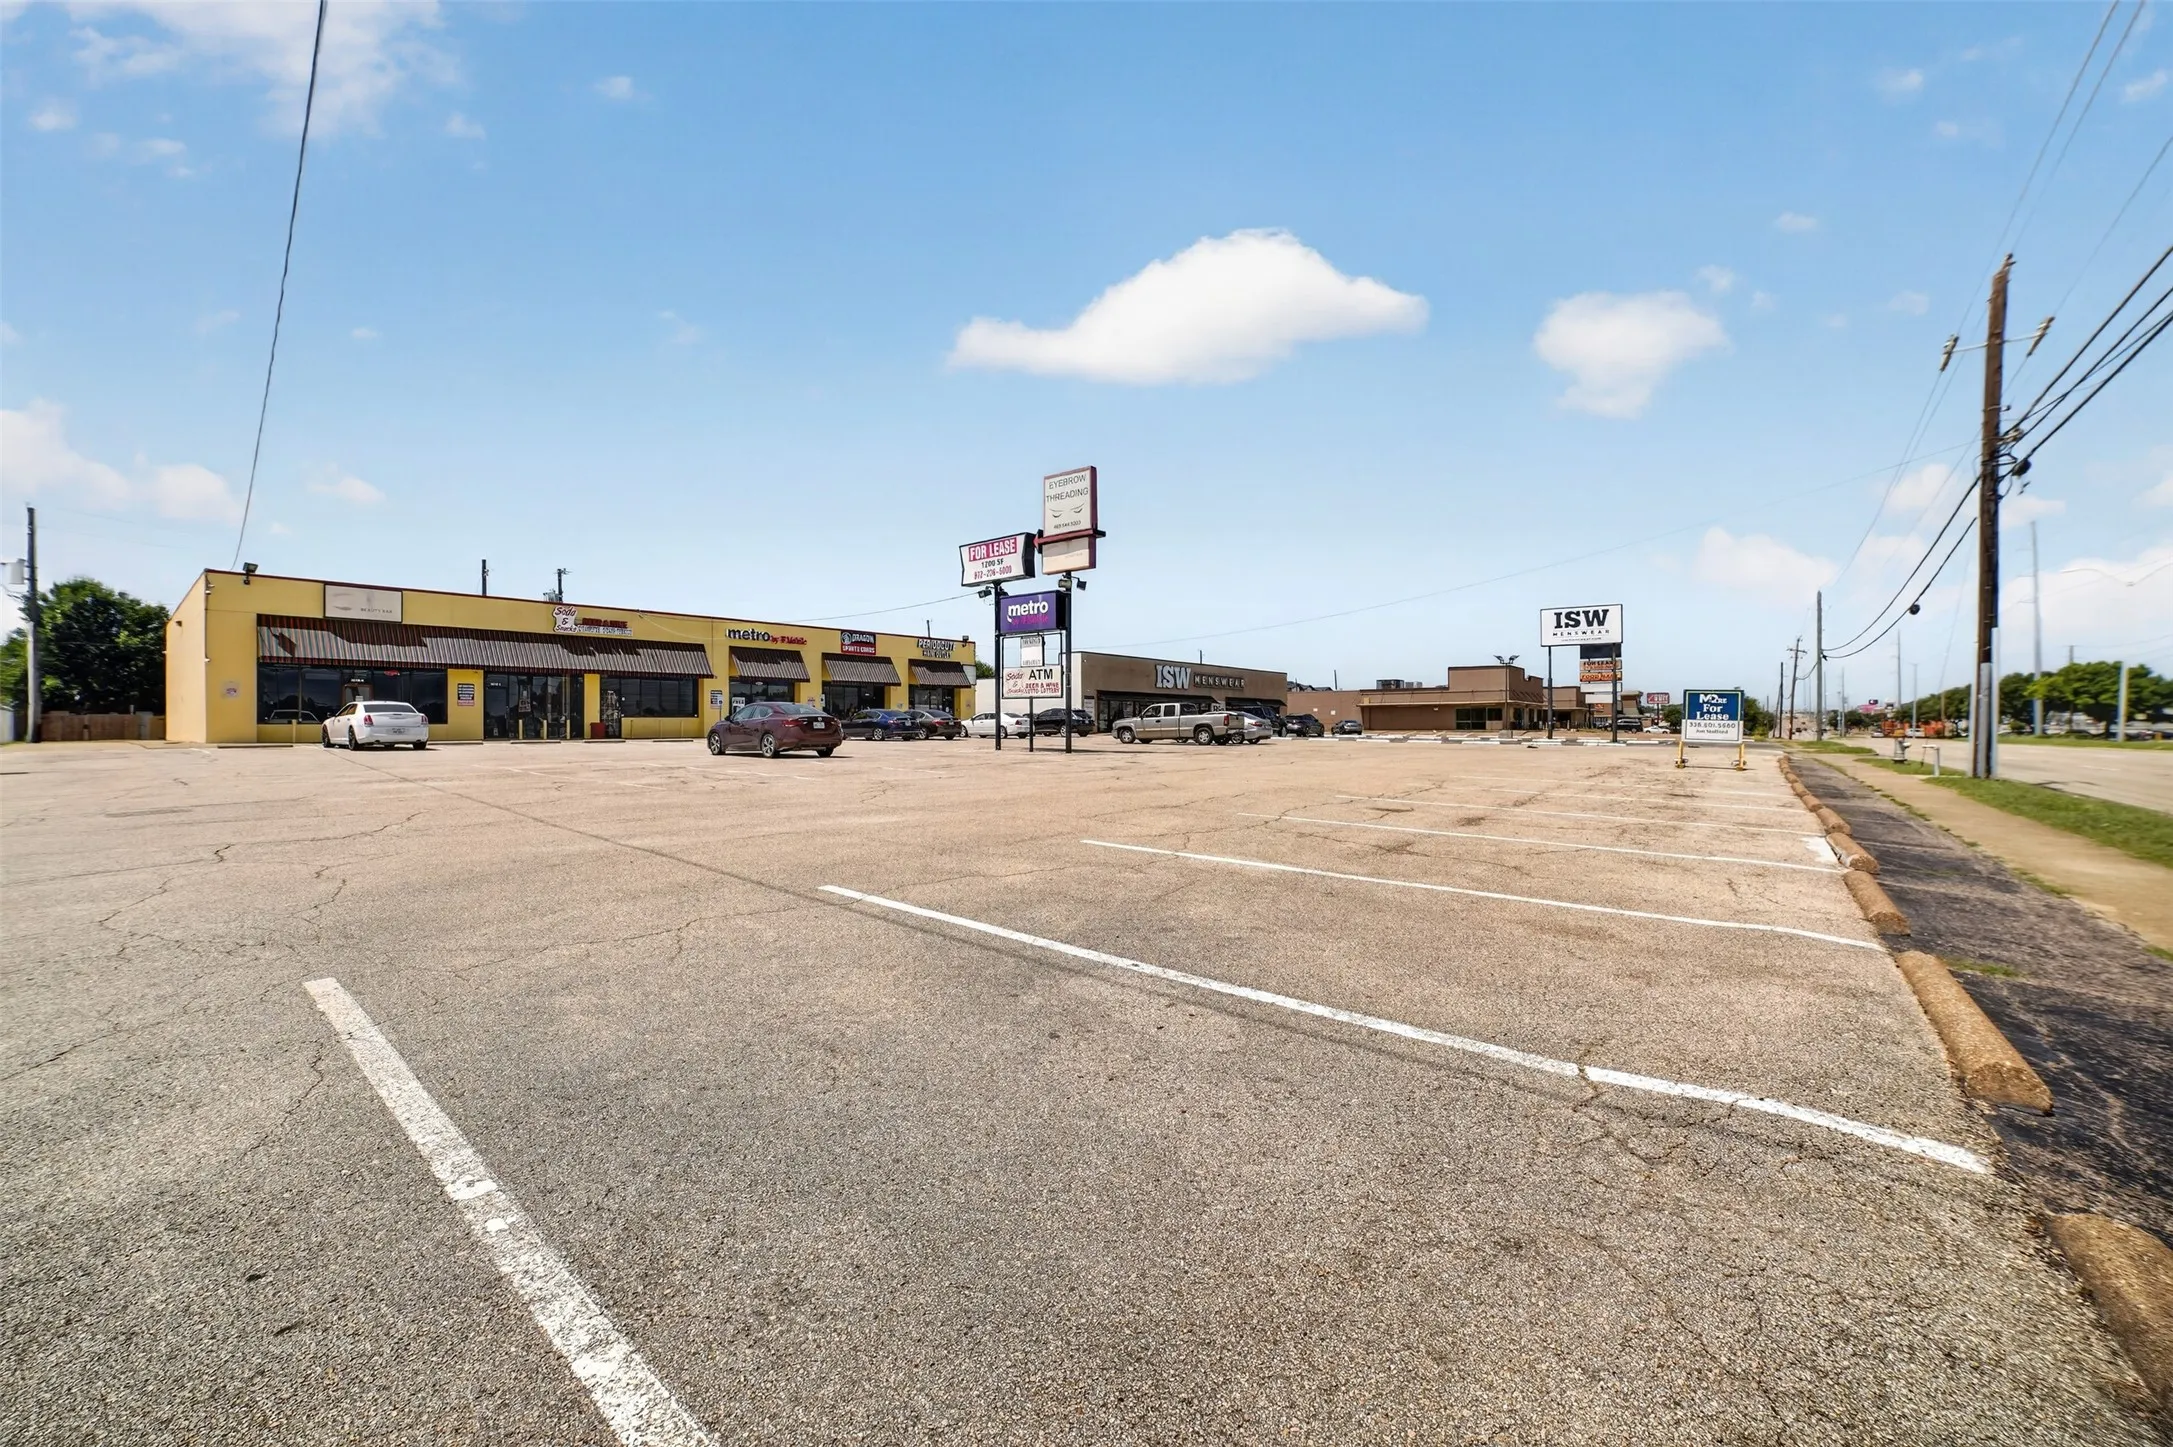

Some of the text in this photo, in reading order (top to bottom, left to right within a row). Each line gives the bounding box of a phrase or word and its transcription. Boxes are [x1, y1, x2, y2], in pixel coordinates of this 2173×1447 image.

[1049, 474, 1087, 489] EYEBROW
[1046, 487, 1089, 502] THREADING
[970, 538, 1016, 561] FOR LEASE
[981, 559, 996, 568] 1200
[554, 605, 577, 617] Soda
[1008, 600, 1049, 616] metro
[561, 617, 569, 625] &
[1553, 608, 1610, 629] ISW
[727, 628, 770, 642] metro
[852, 633, 875, 644] DRAGON
[1006, 672, 1024, 681] Soda
[1029, 668, 1053, 680] ATM
[1155, 664, 1246, 689] ISW MENSWEAR
[1703, 703, 1723, 712] For
[1696, 711, 1729, 720] Lease
